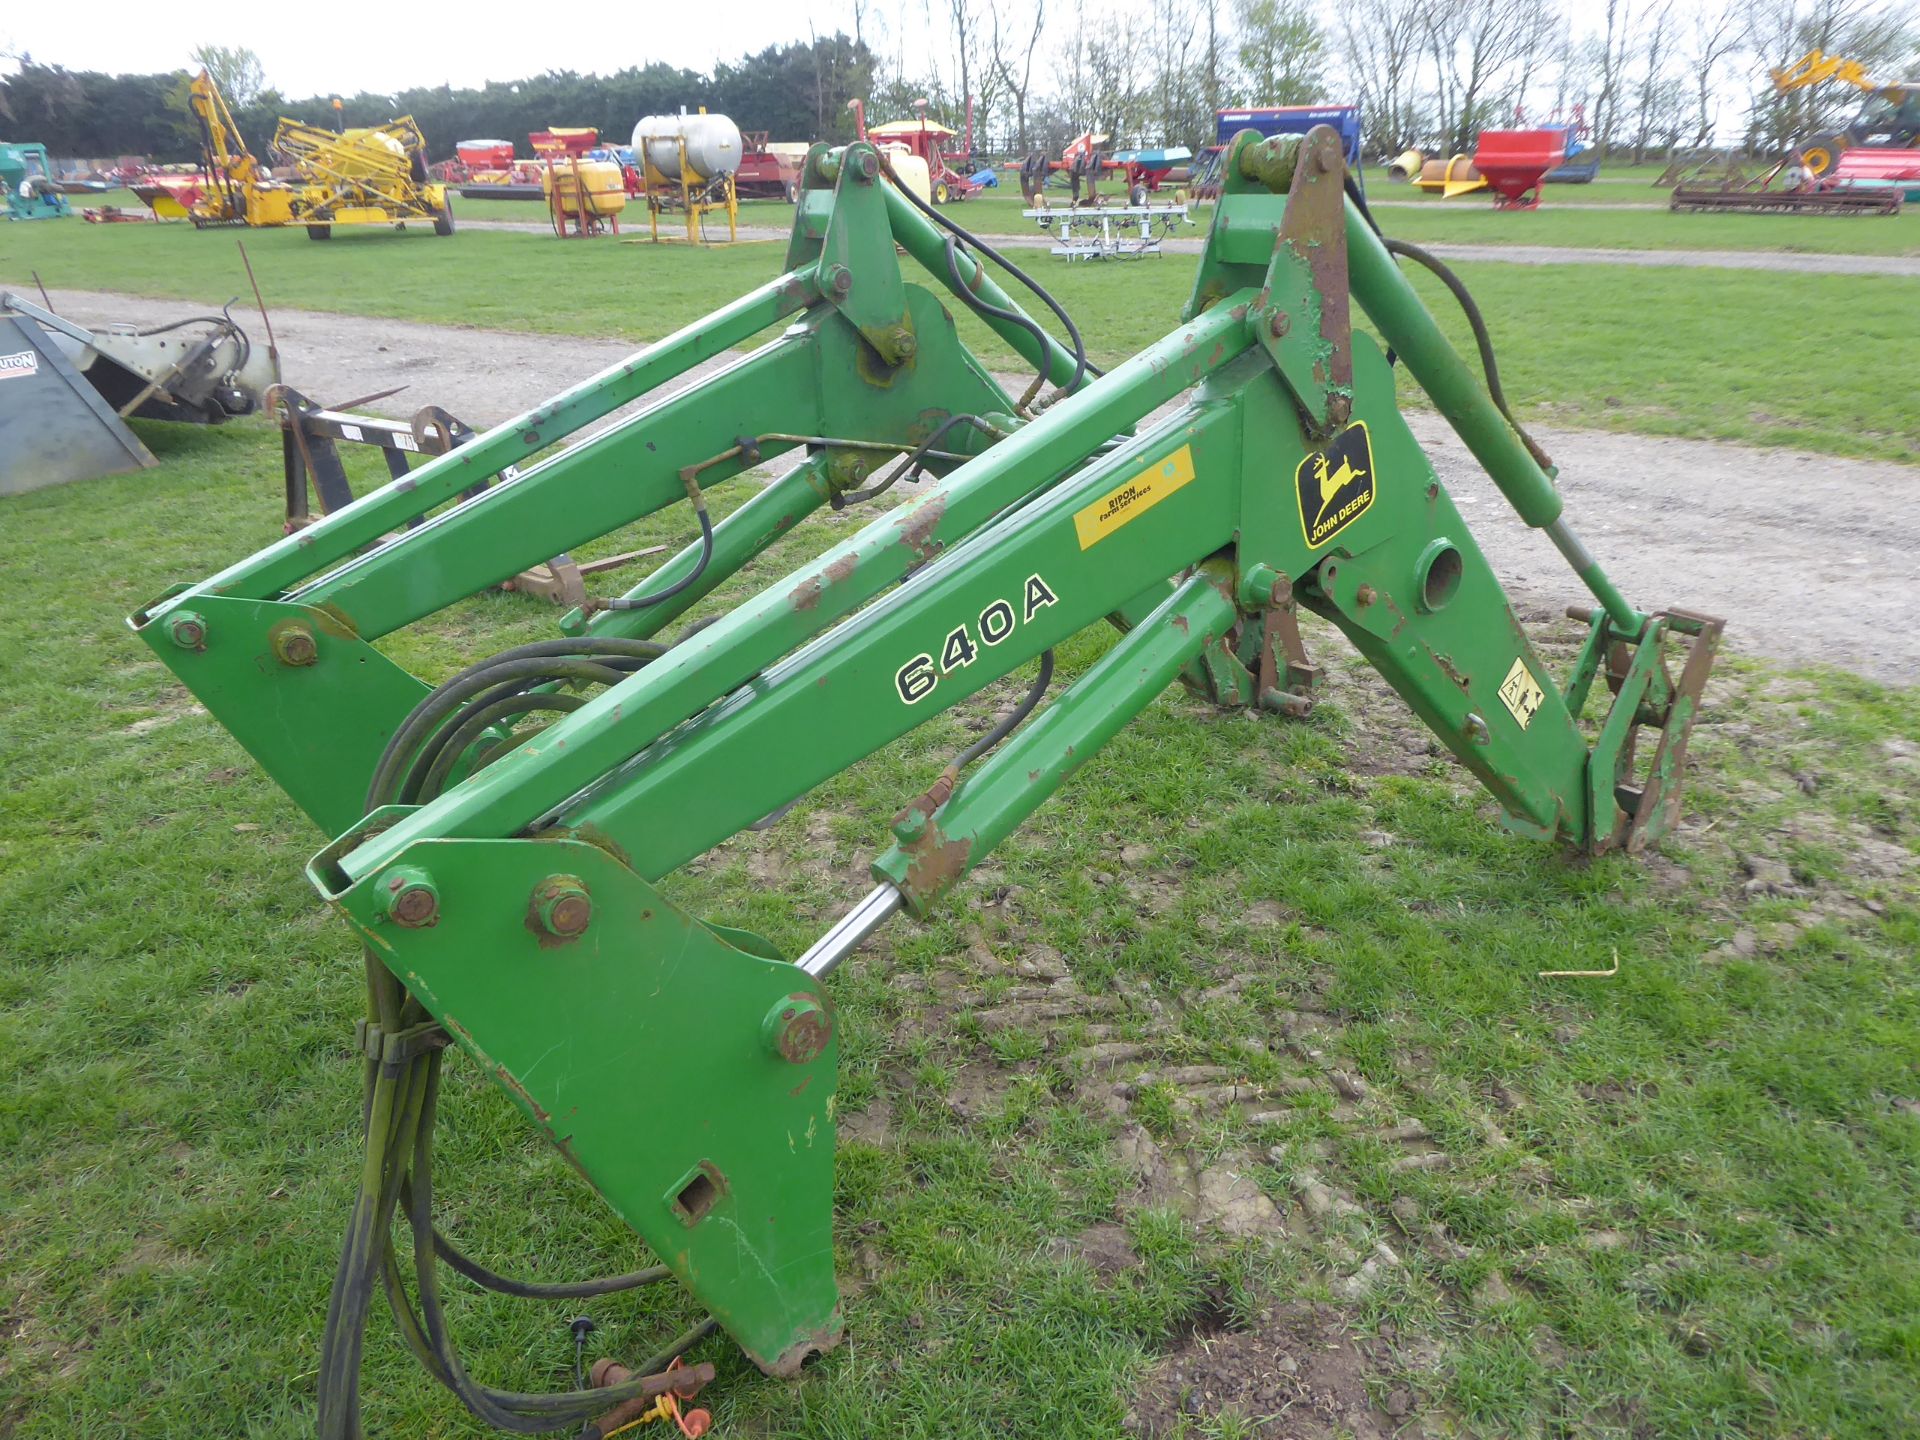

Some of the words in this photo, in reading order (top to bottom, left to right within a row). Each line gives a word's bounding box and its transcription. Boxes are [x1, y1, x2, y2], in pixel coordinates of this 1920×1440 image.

[1108, 485, 1136, 509] RIPON
[1119, 484, 1152, 509] services
[1311, 514, 1338, 542] JOHN
[1338, 489, 1371, 521] DEERE
